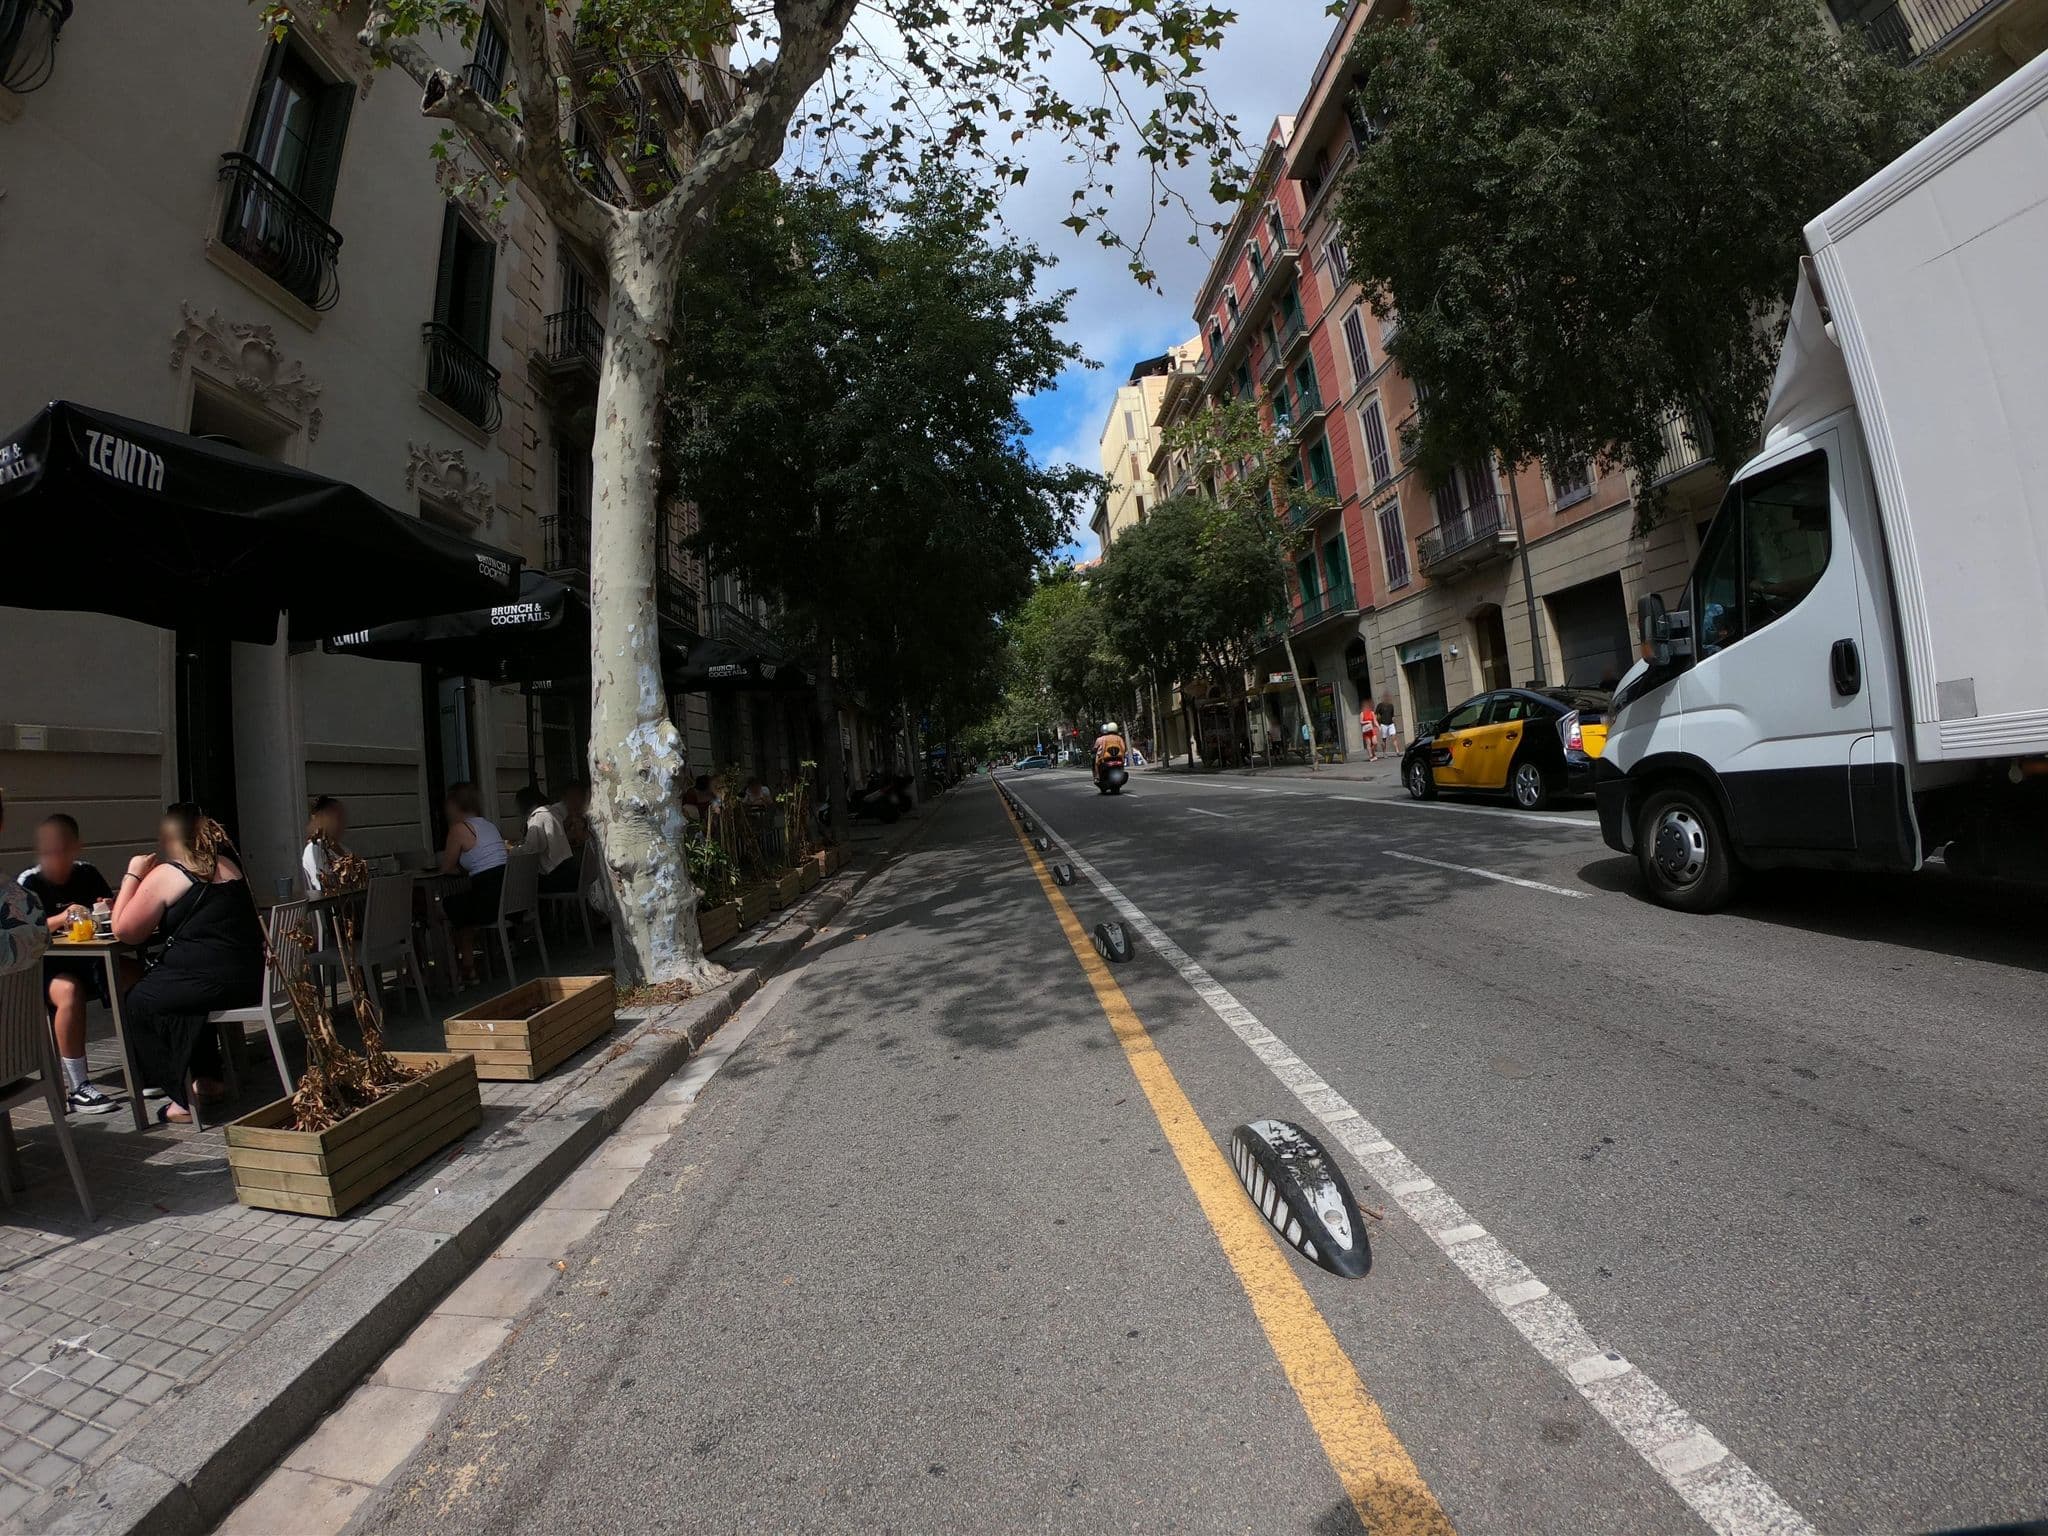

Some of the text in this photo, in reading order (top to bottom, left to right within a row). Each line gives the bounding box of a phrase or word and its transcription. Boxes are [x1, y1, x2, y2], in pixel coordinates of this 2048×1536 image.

[86, 429, 165, 491] ZENITH
[491, 603, 542, 616] BRUNCH &
[491, 611, 551, 625] COCKTAILS
